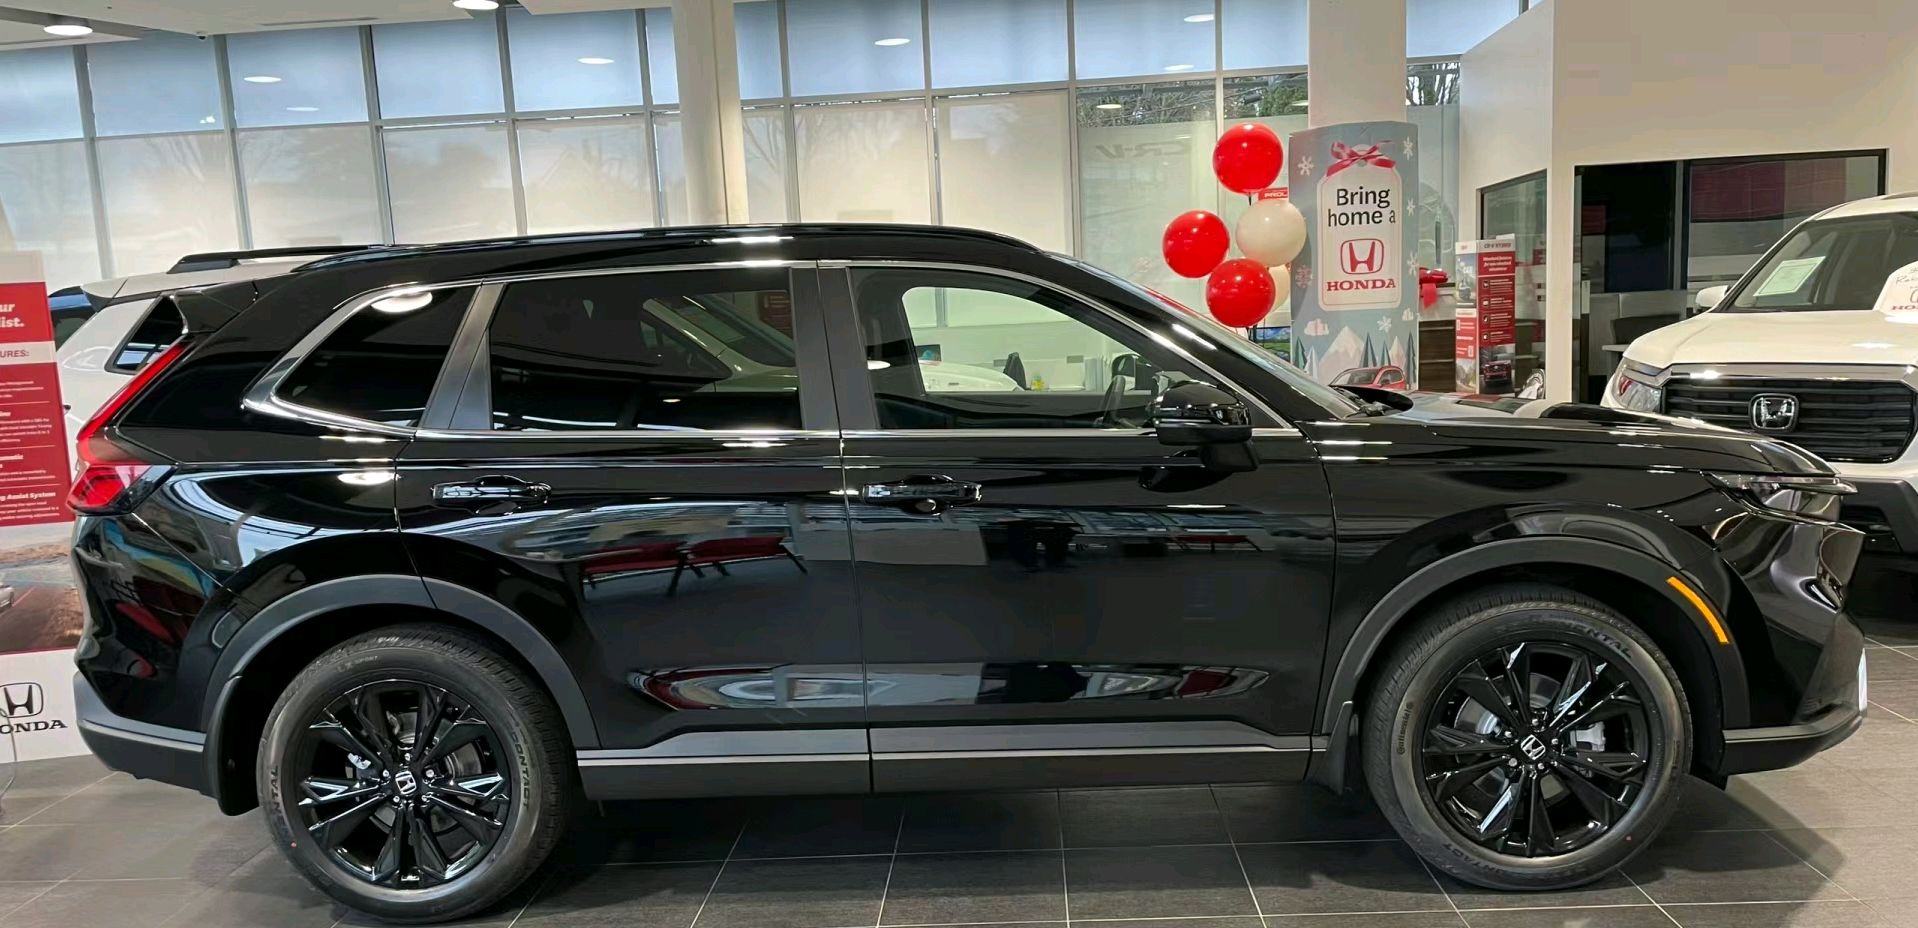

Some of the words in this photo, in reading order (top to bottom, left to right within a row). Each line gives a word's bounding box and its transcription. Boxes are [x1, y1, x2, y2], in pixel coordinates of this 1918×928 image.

[1336, 186, 1391, 208] Bring
[1327, 208, 1383, 227] home
[1389, 210, 1396, 224] a
[1326, 279, 1396, 292] HONDA
[0, 719, 67, 734] ONDA
